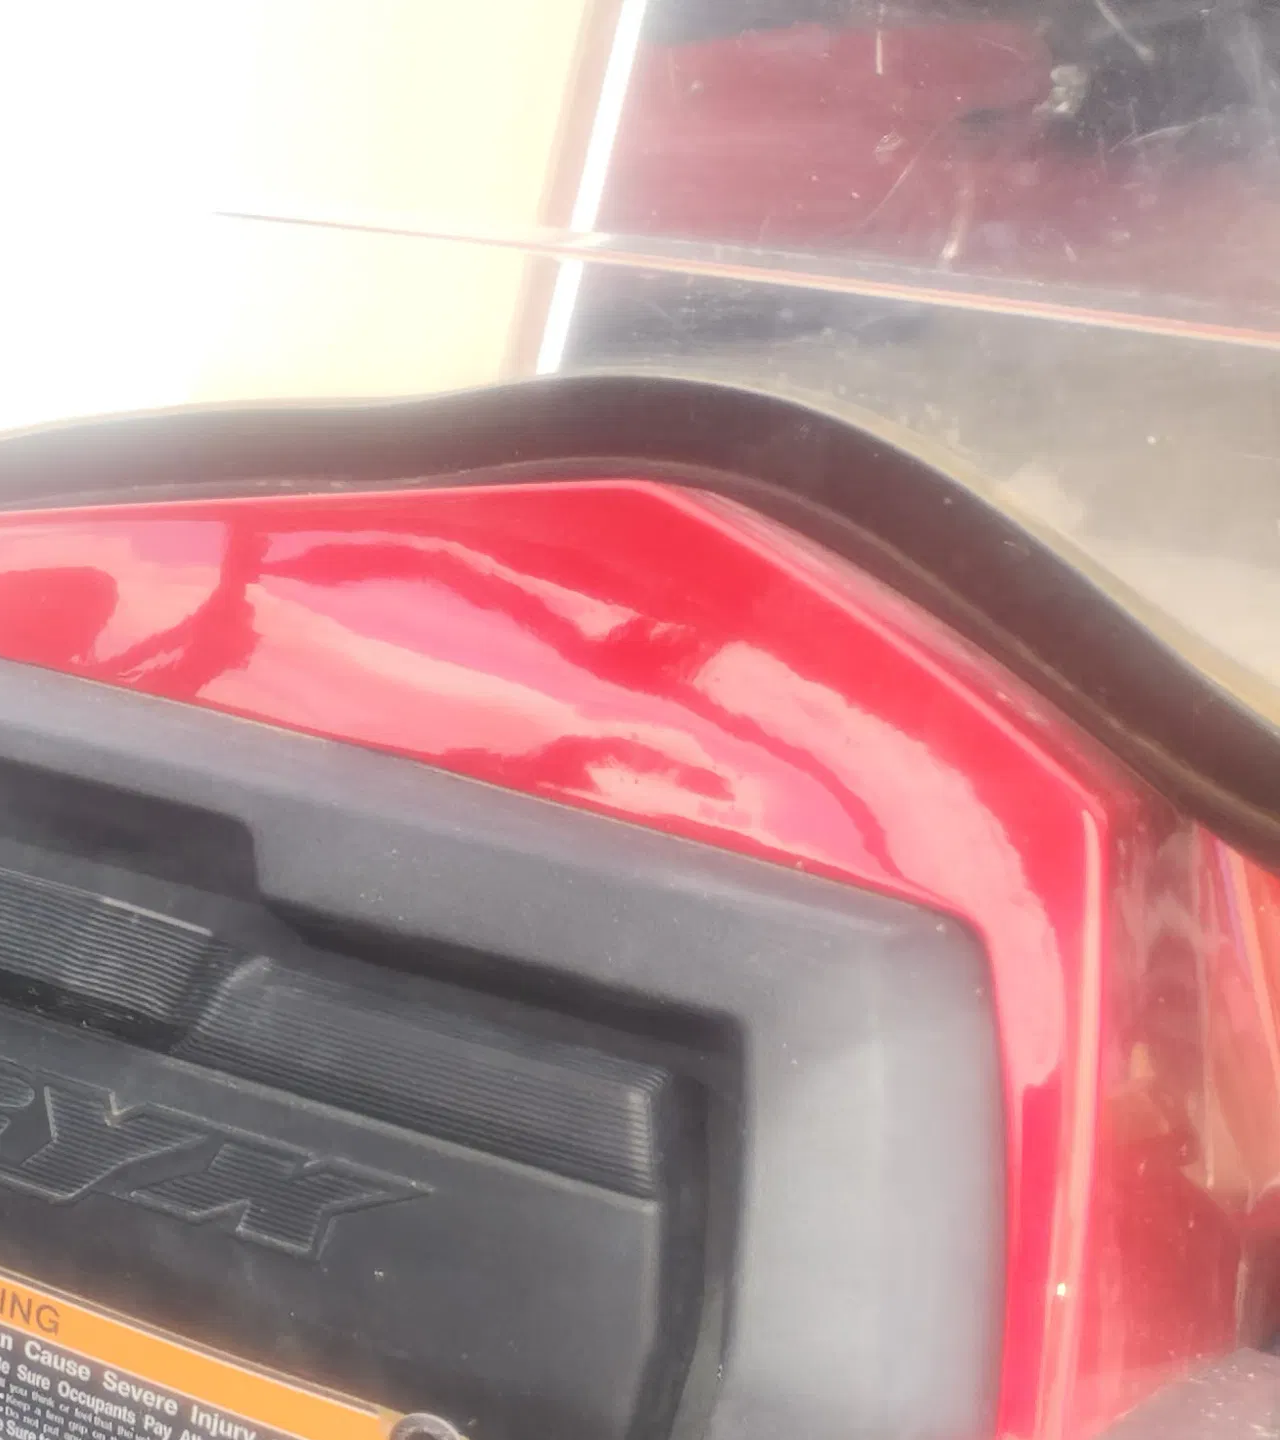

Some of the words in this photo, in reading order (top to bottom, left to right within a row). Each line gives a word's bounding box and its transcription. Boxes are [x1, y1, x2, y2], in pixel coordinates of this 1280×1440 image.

[17, 1364, 50, 1390] Sure
[58, 1381, 135, 1424] Occupants
[24, 1340, 90, 1380] Cause
[103, 1371, 177, 1414] Severe
